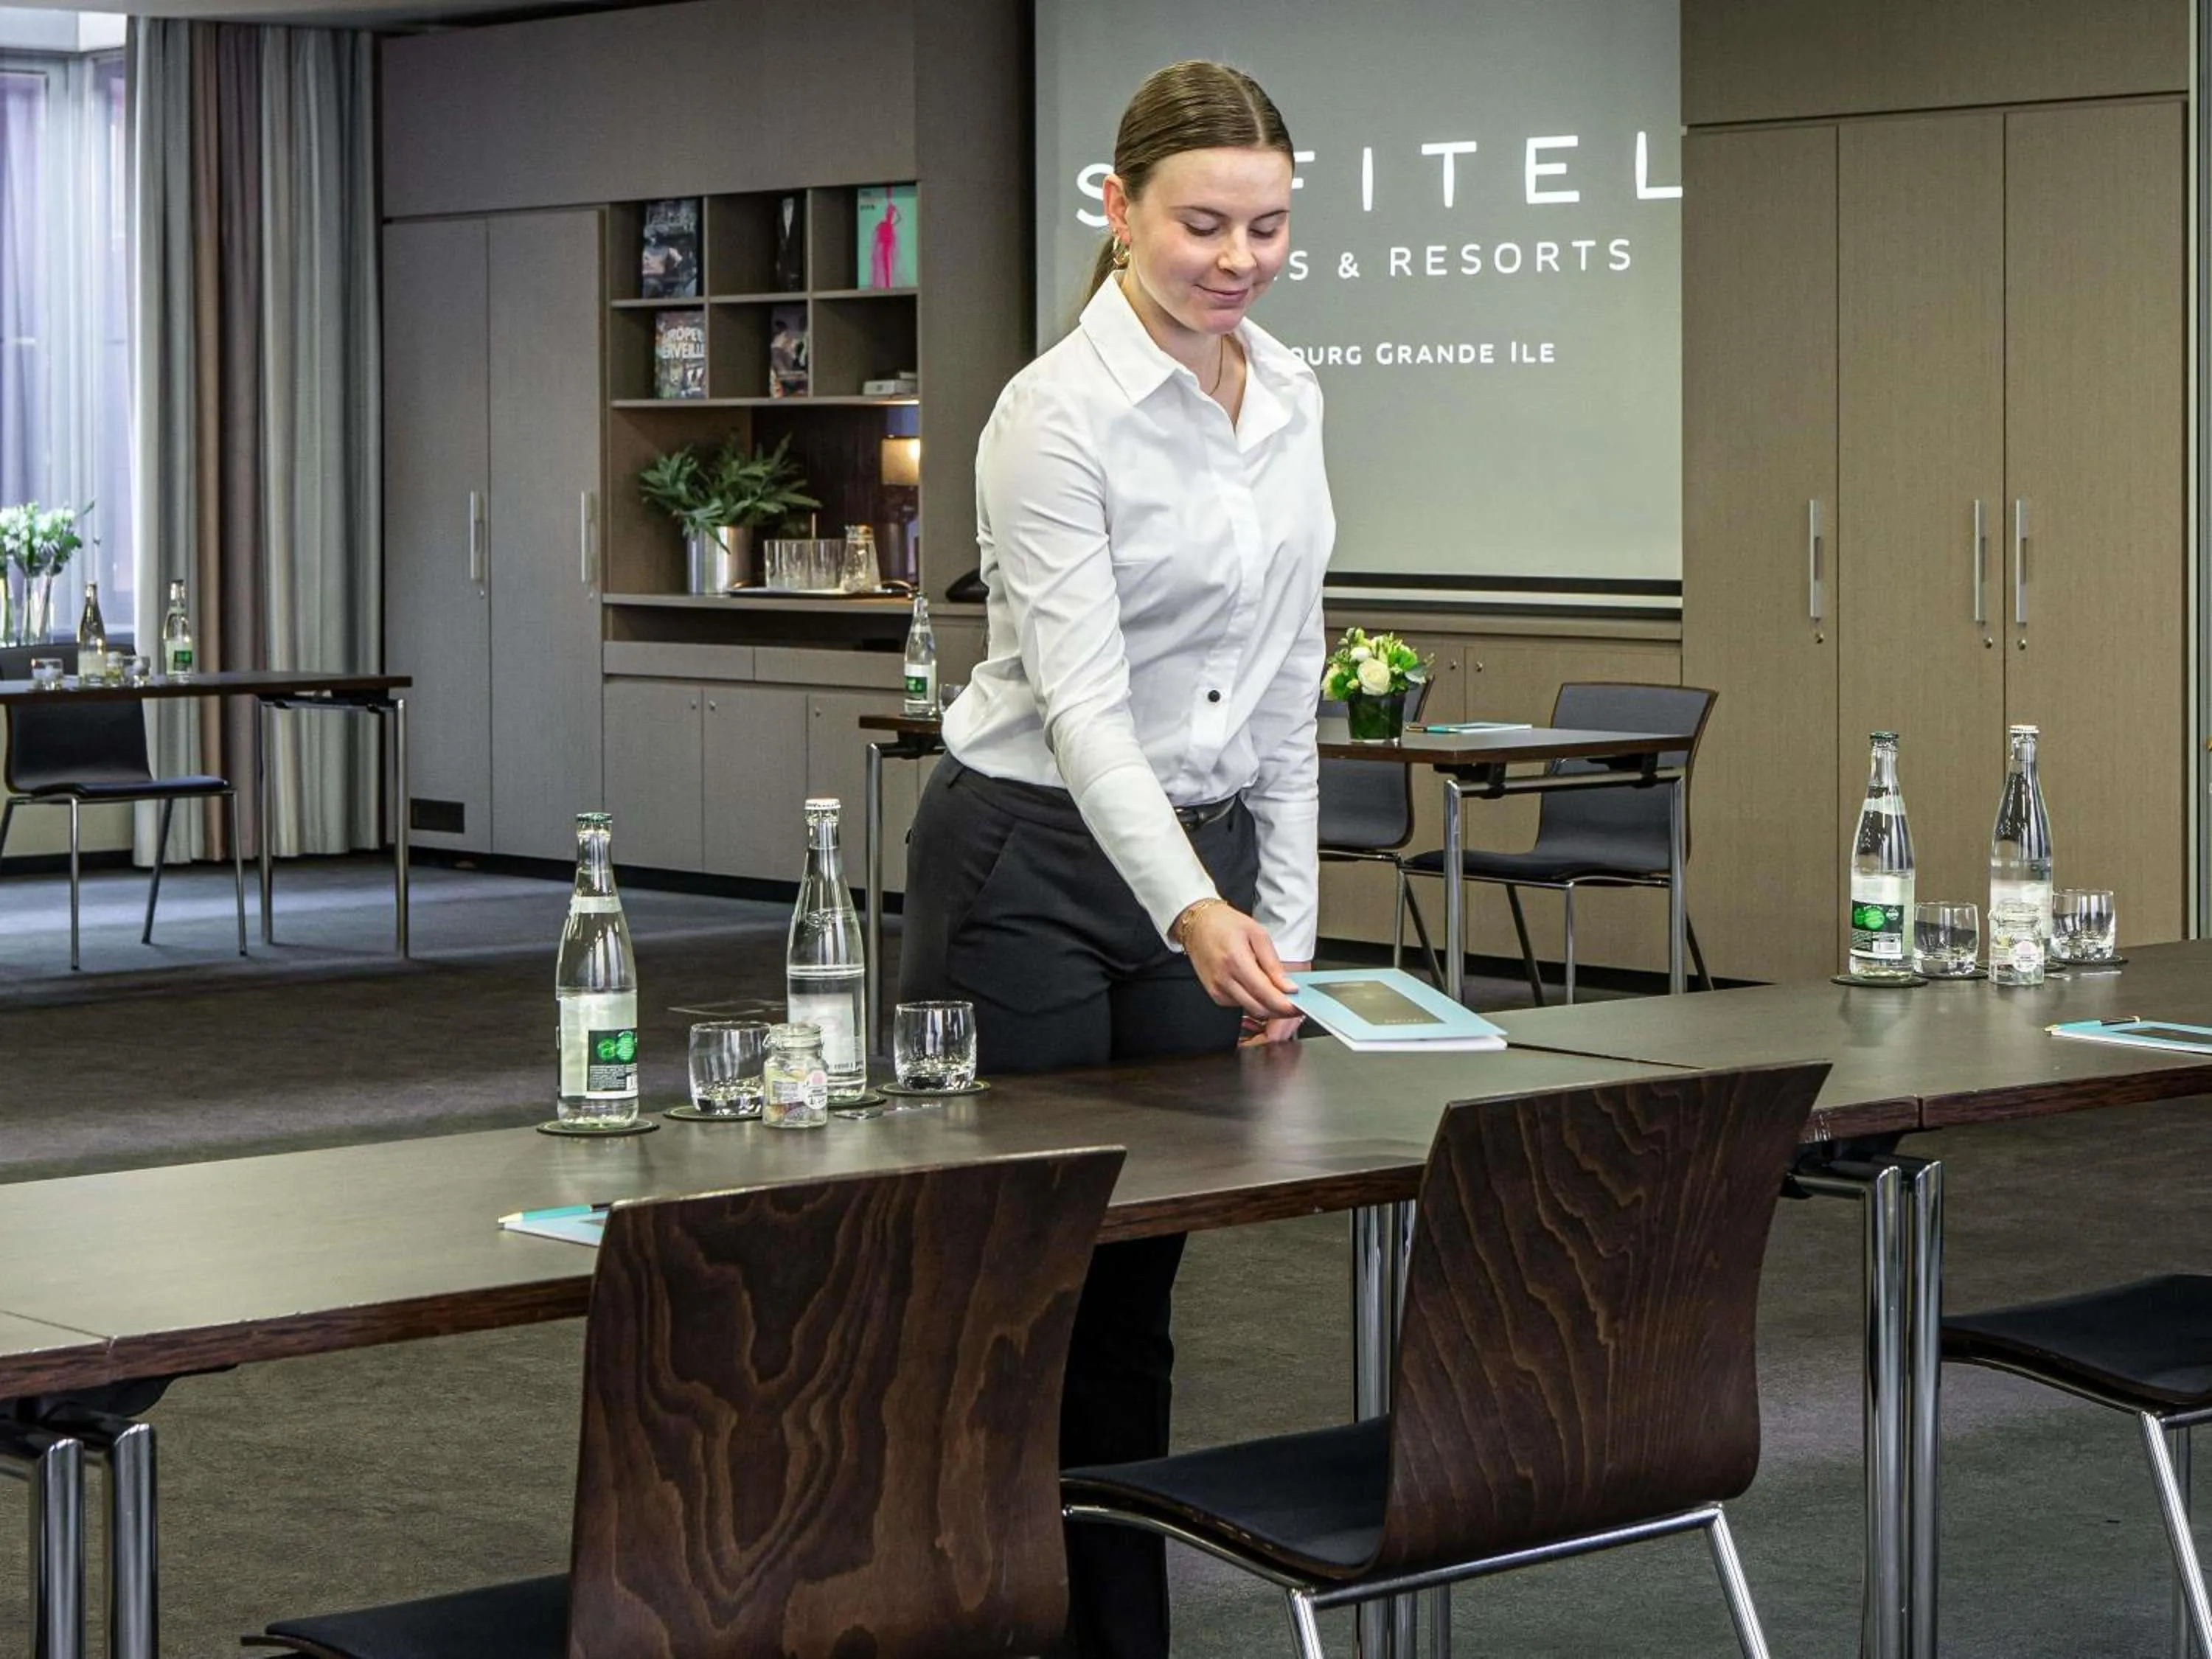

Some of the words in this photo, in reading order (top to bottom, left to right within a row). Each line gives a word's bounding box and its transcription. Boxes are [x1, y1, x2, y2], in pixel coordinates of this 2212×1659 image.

[1338, 251, 1360, 279] &
[1390, 238, 1631, 277] RESORTS
[1376, 341, 1495, 365] GRANDE
[1511, 341, 1555, 364] ILE
